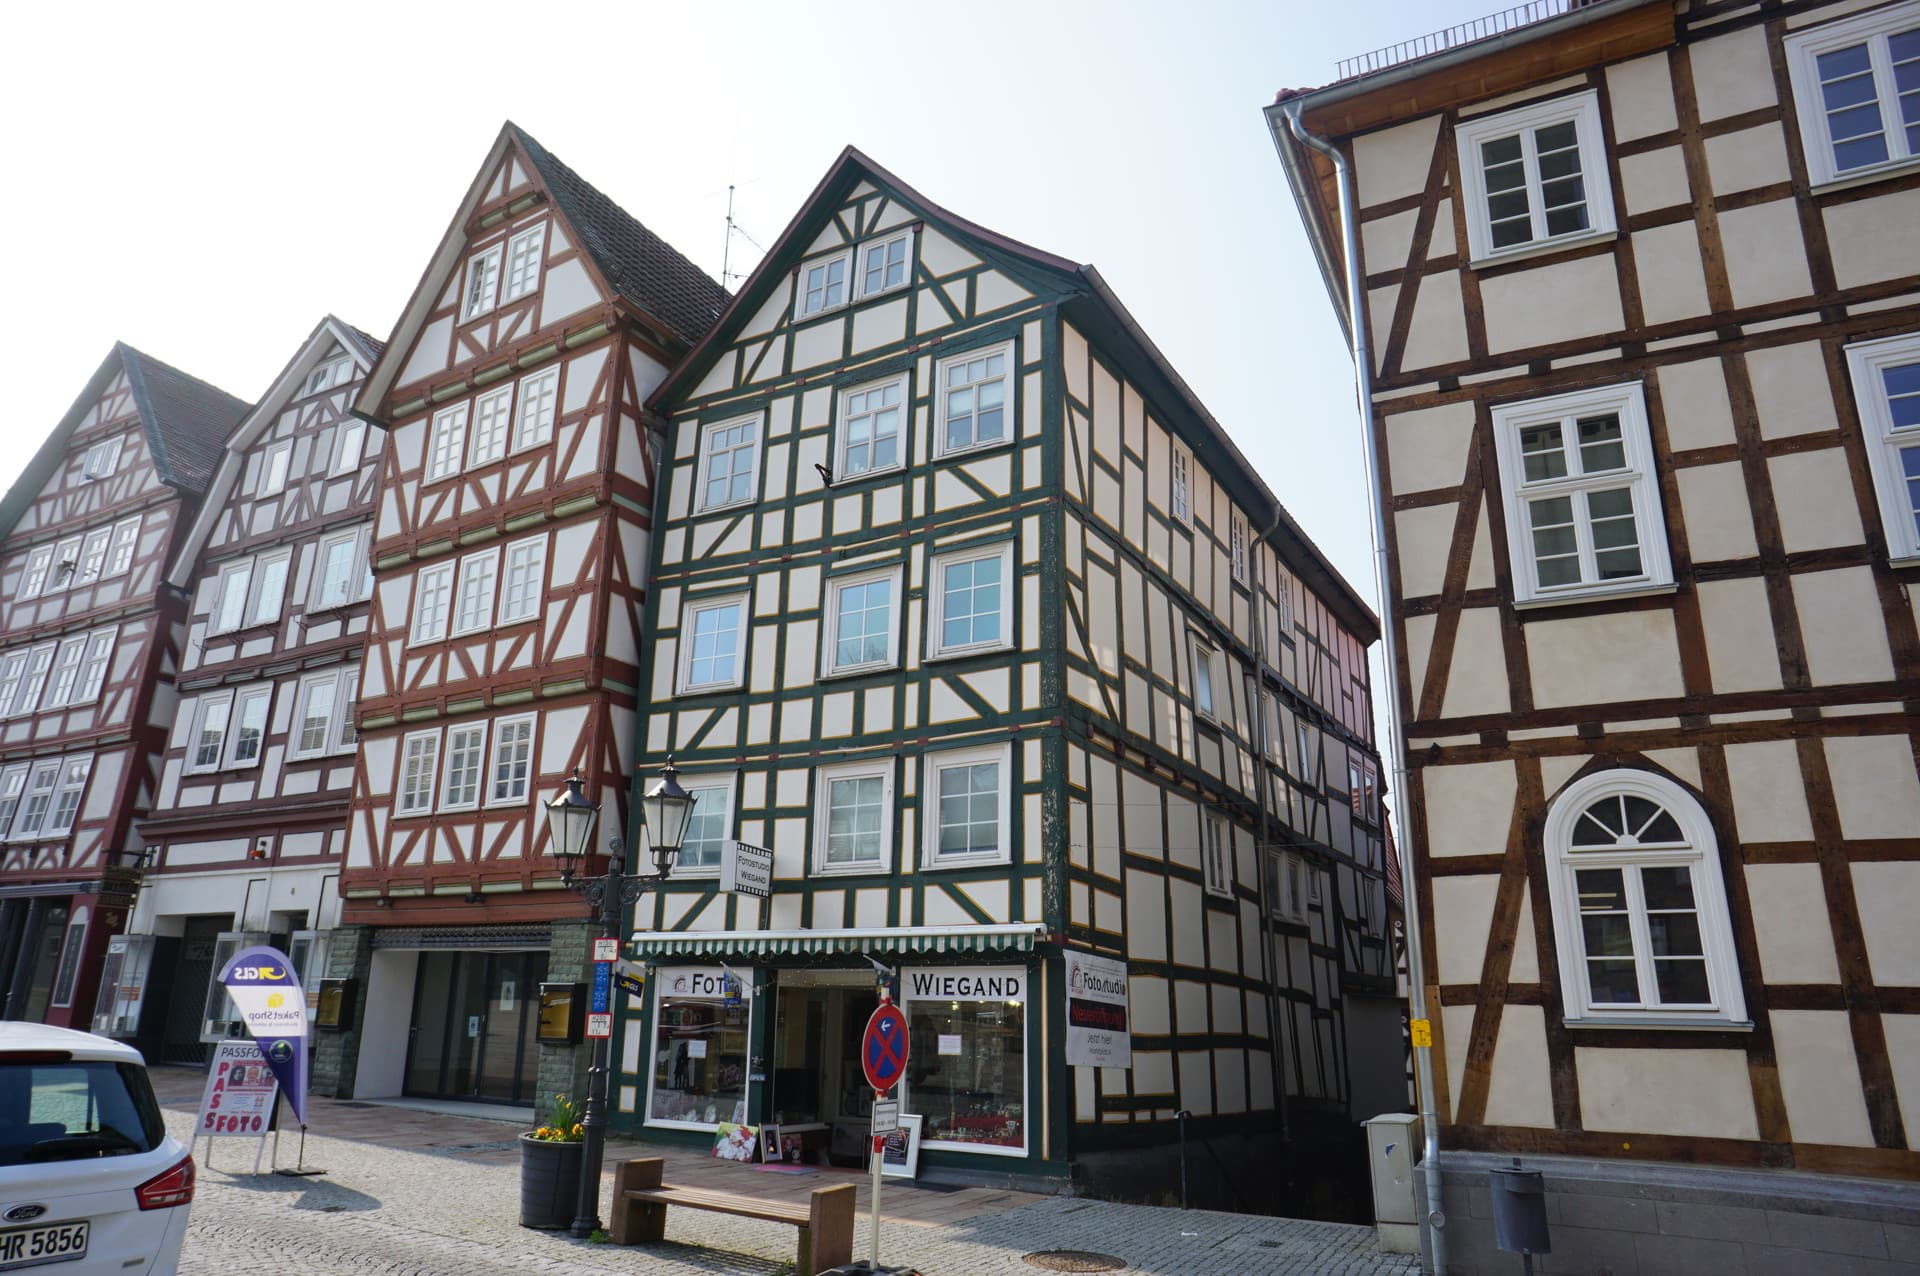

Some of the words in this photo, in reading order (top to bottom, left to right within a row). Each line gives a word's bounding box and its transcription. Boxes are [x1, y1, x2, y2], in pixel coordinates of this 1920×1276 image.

[738, 855, 769, 871] FOTOSTUDIO
[692, 974, 725, 994] FOT
[912, 973, 1020, 997] WIEGAND
[221, 1046, 264, 1058] PASSFO
[30, 1226, 84, 1257] 5856
